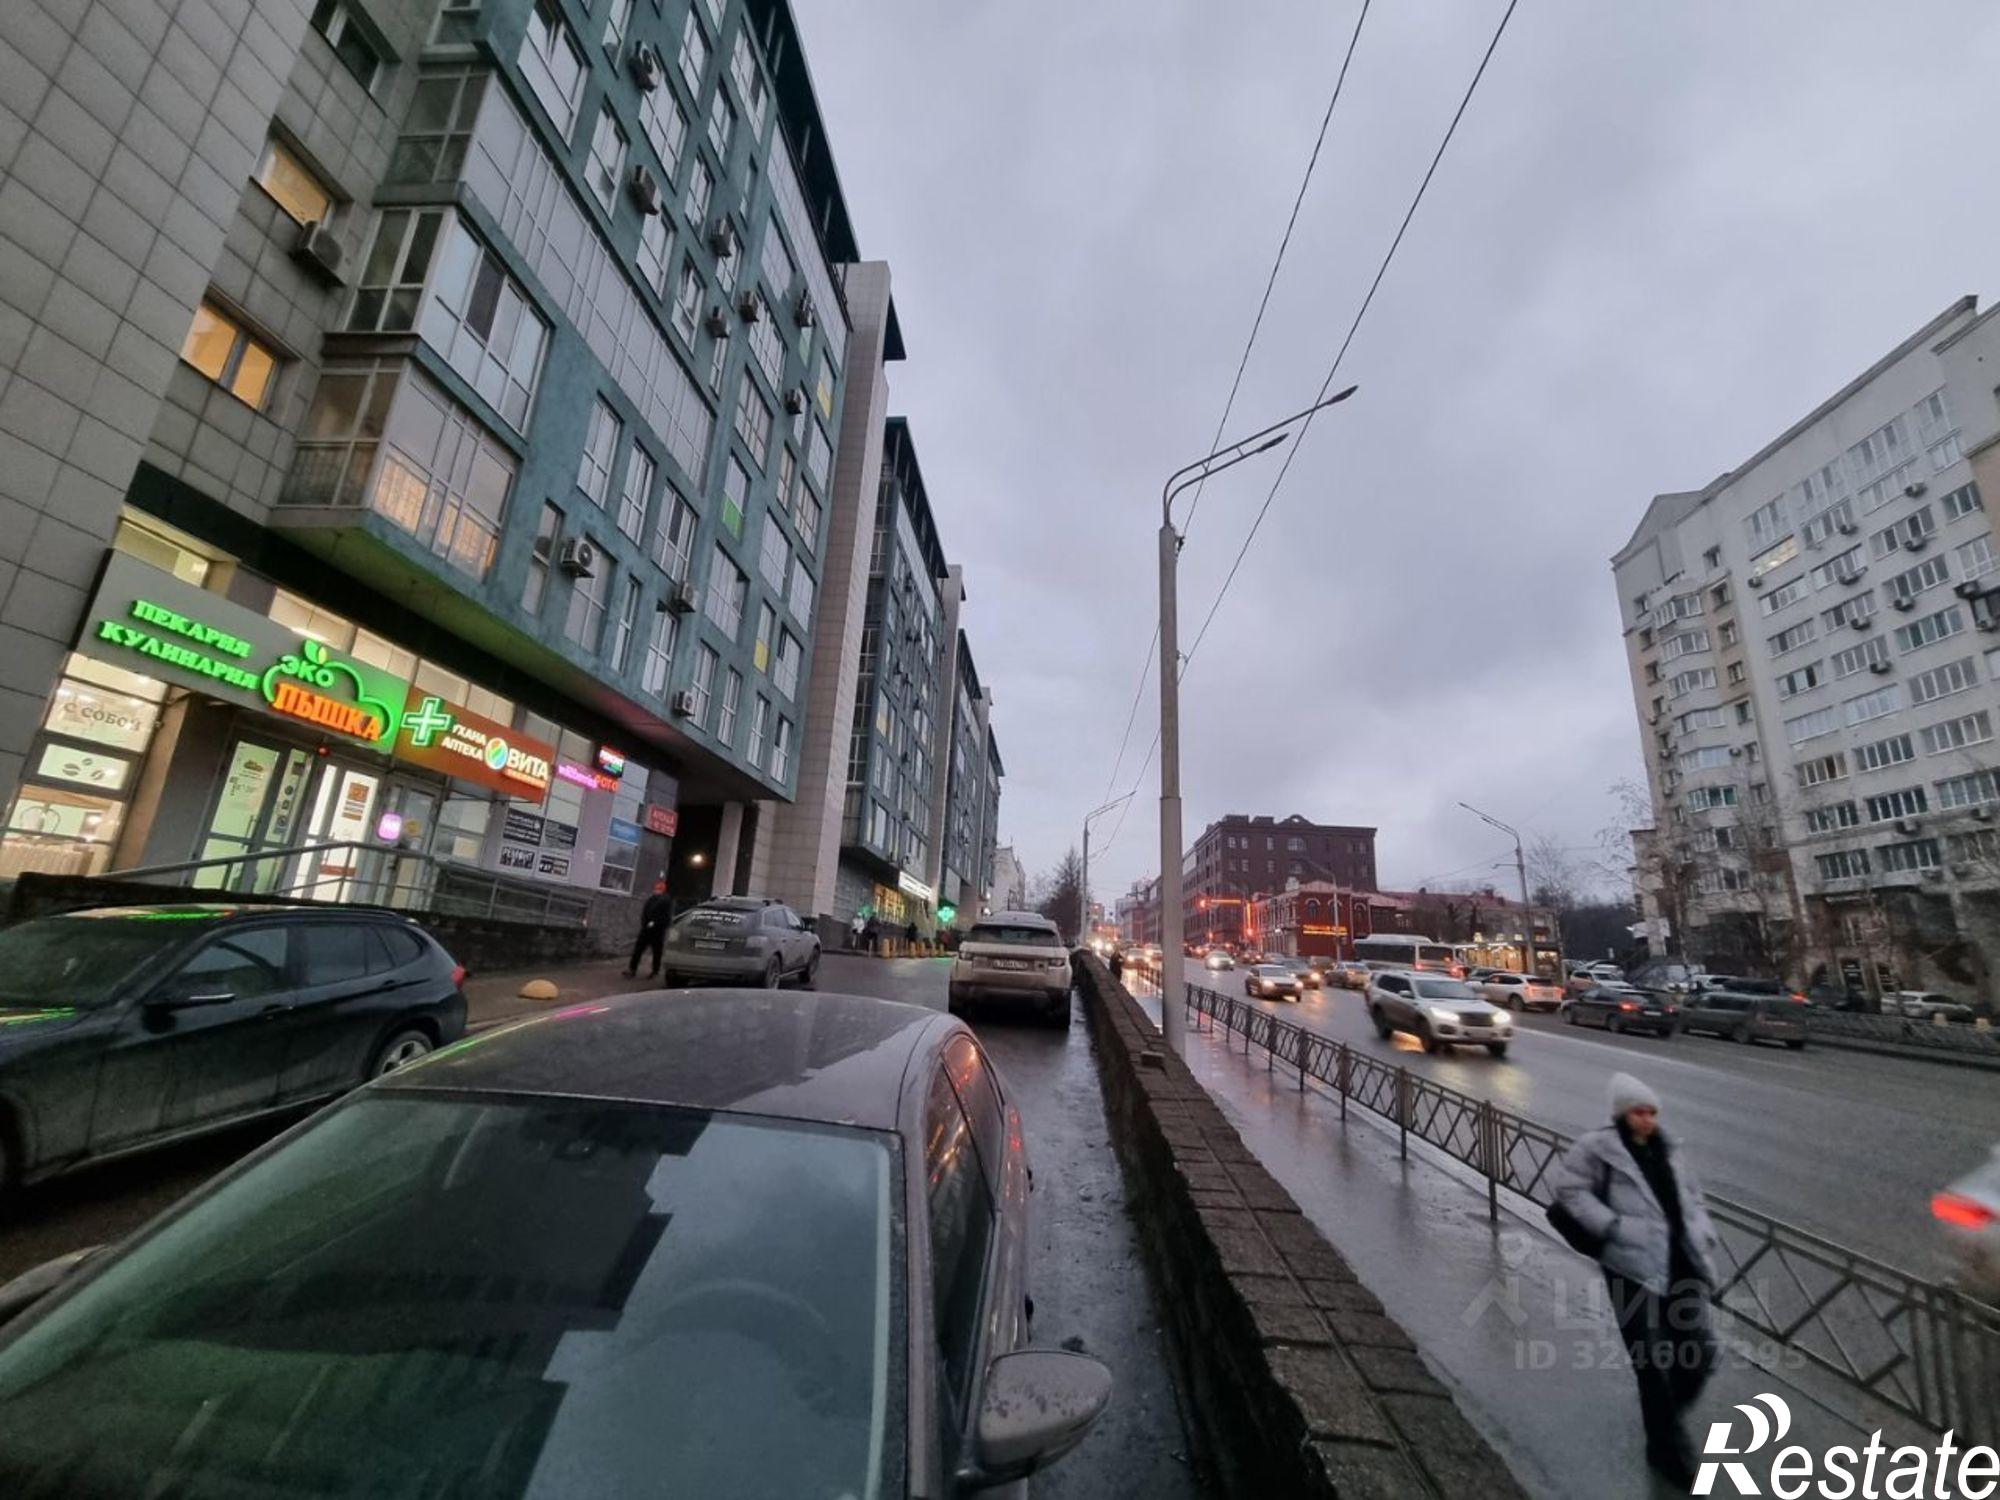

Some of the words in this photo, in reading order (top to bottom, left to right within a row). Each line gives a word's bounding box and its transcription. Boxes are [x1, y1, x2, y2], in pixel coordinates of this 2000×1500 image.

[133, 599, 251, 658] ПЕКАРНЯ
[100, 621, 260, 690] КУЛИНАРИЯ
[280, 655, 336, 688] ЭКО
[272, 682, 381, 742] ПЫШКА
[442, 736, 484, 761] АПТЕКА
[506, 748, 549, 780] ВИТА
